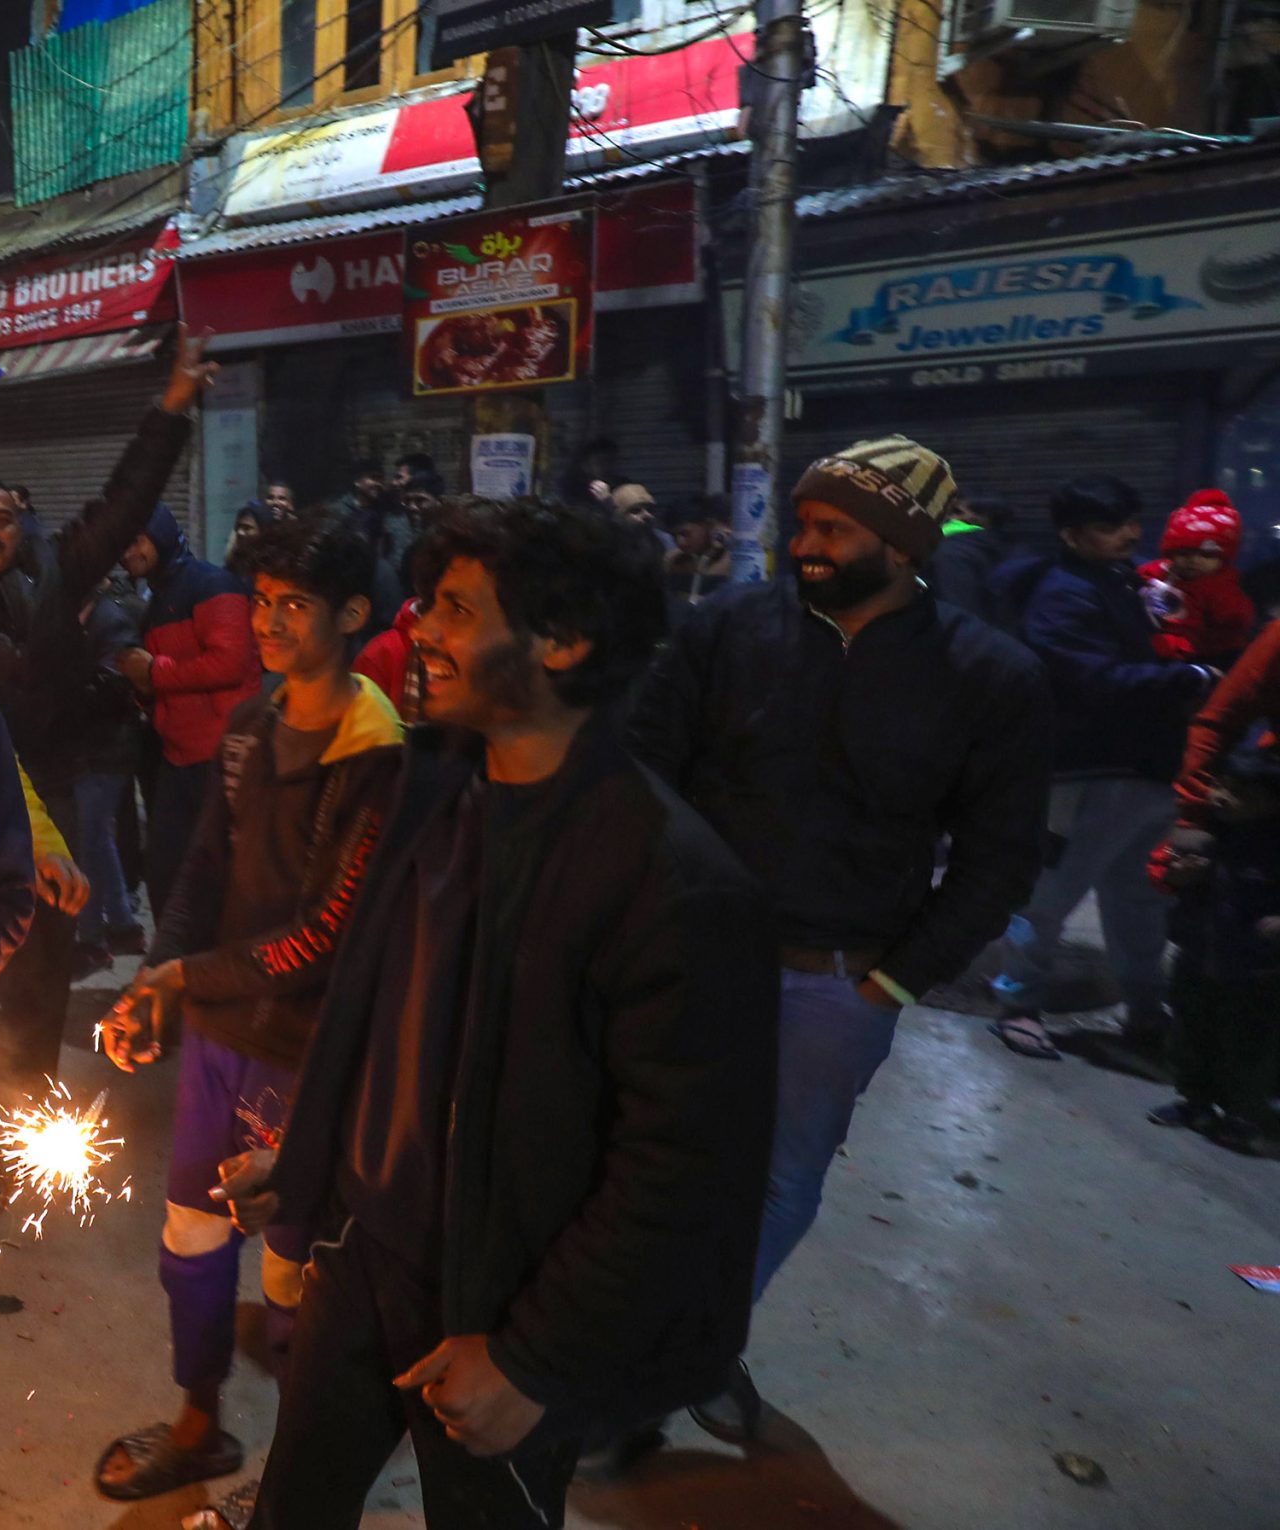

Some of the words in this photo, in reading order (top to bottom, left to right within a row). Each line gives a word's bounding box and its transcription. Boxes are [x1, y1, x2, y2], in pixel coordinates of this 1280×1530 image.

[14, 251, 156, 306] BROTHERS
[436, 253, 553, 286] BURAQ
[886, 262, 1117, 312] RAJESH
[14, 307, 59, 334] SINCE
[63, 299, 102, 323] 1947
[896, 314, 1105, 352] Jewellers
[911, 366, 984, 387] GOLD
[995, 357, 1087, 381] SMITH
